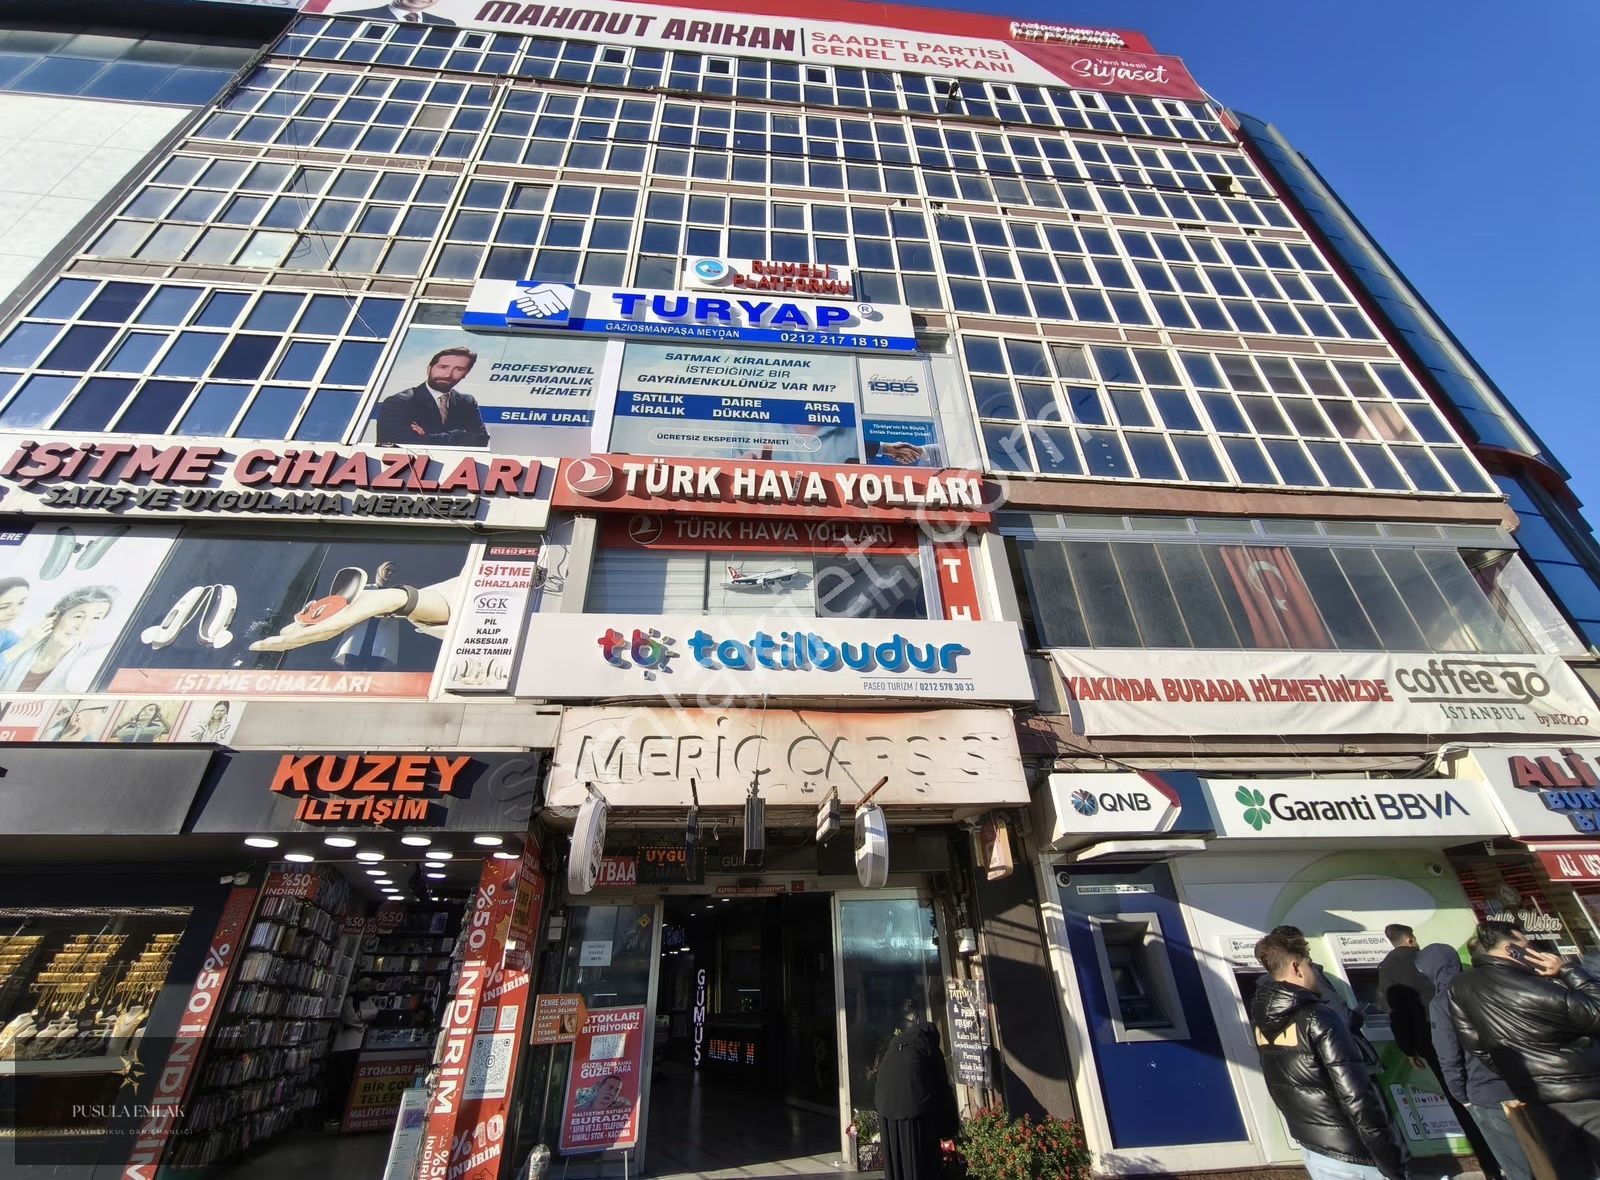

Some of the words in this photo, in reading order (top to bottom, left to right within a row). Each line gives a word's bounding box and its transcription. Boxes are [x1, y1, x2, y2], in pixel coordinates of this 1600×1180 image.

[474, 0, 657, 36] MAHMUT
[661, 18, 796, 51] ARIKAN
[811, 32, 909, 49] SAADET
[916, 42, 1010, 60] PARTİSİ
[812, 44, 896, 60] GENEL
[904, 52, 1015, 73] BAŞKANI
[1071, 57, 1169, 86] Siyaset
[733, 274, 850, 295] PLATFORMU
[612, 293, 851, 329] TURYAP
[697, 328, 740, 339] MEYDAN
[780, 333, 815, 343] 0212
[820, 336, 845, 345] 217
[851, 337, 867, 346] 18
[872, 338, 888, 347] 19
[664, 352, 722, 364] SATMAK
[733, 354, 811, 368] KİRALAMAK
[490, 362, 595, 374] PROFESYONEL
[489, 374, 593, 385] DANIŞMANLIK
[637, 374, 777, 390] GAYRİMENKULÜNÜZ
[782, 381, 808, 391] VAR
[530, 385, 592, 396] HİZMETİ
[868, 381, 919, 393] 1985
[632, 393, 683, 404] SATILIK
[721, 396, 762, 408] DAİRE
[631, 403, 685, 416] KİRALIK
[712, 408, 770, 420] DÜKKAN
[805, 402, 840, 413] ARSA
[500, 410, 547, 421] SELİM
[552, 413, 590, 423] URAL
[808, 412, 841, 424] BİNA
[657, 432, 700, 441] ÜCRETSİZ
[703, 435, 750, 444] EKSPERTİZ
[753, 437, 789, 446] HİZMETİ
[233, 449, 542, 496] CİHAZLARI
[623, 458, 721, 498] TÜRK
[734, 468, 827, 502] HAVA
[838, 472, 982, 506] YOLLARI
[40, 485, 131, 512] SATIŞ
[136, 487, 182, 508] VE
[182, 489, 343, 514] UYGULAMA
[350, 493, 480, 518] MERKEZİ
[674, 515, 733, 539] TÜRK
[740, 519, 798, 541] HAVA
[803, 523, 893, 543] YOLLARI
[478, 563, 531, 577] İŞİTME
[474, 578, 530, 589] CİHAZLARI
[478, 597, 509, 609] SGK
[484, 617, 497, 625] PİL
[464, 637, 508, 645] AKSESUAR
[456, 647, 482, 656] CİHAZ
[483, 647, 512, 656] TAMİRİ
[687, 629, 971, 672] tatilbudur
[174, 672, 254, 694] İŞİTME
[1395, 658, 1499, 695] coffee
[863, 681, 886, 691] PASEO
[888, 681, 913, 691] TURİZM
[920, 682, 938, 691] 0212
[939, 682, 953, 691] 578
[954, 682, 964, 691] 30
[965, 682, 975, 691] 33
[1062, 676, 1162, 702] YAKINDA
[1161, 678, 1251, 702] BURADA
[1252, 673, 1394, 702] HİZMETİNİZDE
[1440, 703, 1525, 721] İSTANBUL
[270, 754, 472, 793] KUZEY
[294, 794, 429, 825] İLETİŞİM
[1099, 793, 1151, 812] QNB
[1269, 793, 1376, 821] Garanti
[1374, 790, 1470, 820] BBVA
[283, 872, 311, 887] %50
[265, 886, 308, 897] İNDİRİM
[1518, 909, 1563, 932] Usta
[1347, 937, 1368, 946] Garanti
[482, 973, 530, 1004] İNDİRİM
[584, 1011, 640, 1025] STOKLARI
[693, 968, 706, 1066] GÜMÜŞ
[581, 1022, 639, 1034] BİTİRİYORUZ
[571, 1113, 631, 1126] BURADA
